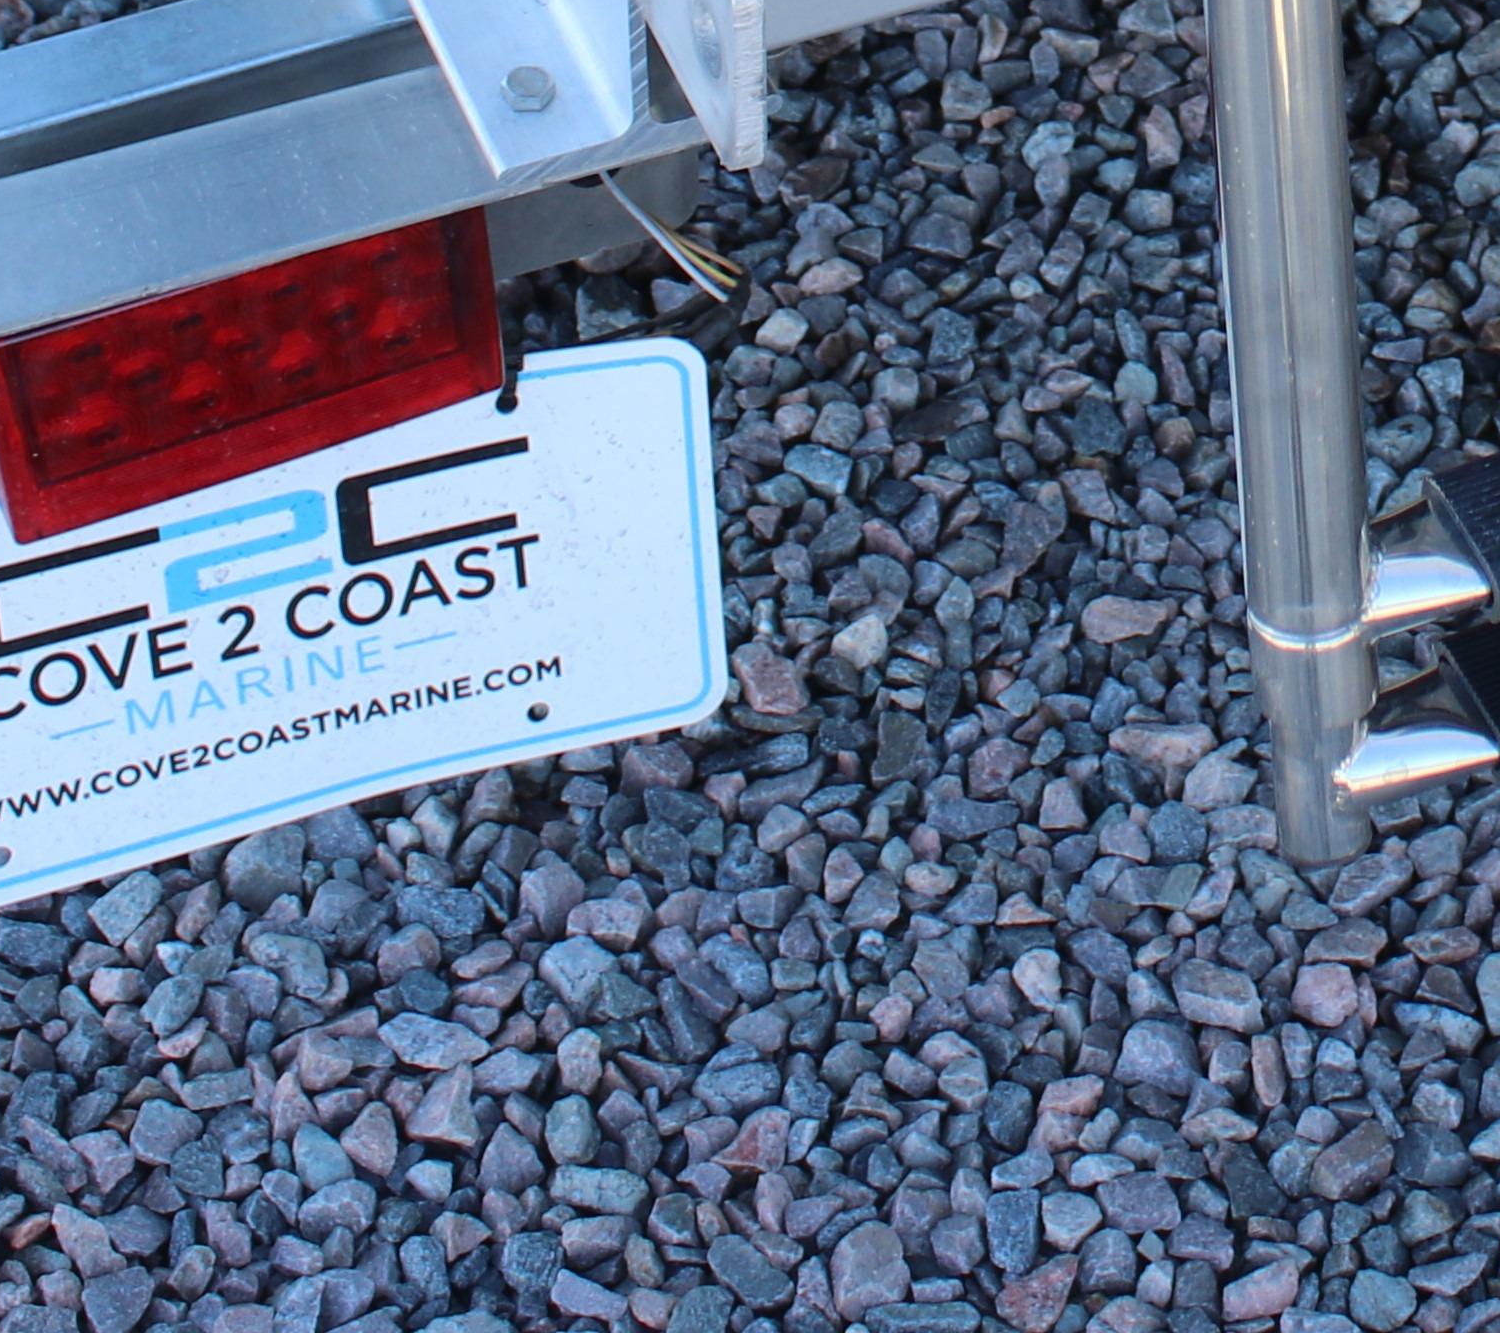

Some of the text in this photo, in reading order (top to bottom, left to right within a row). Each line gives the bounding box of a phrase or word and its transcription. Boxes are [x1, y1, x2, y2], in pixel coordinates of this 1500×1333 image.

[219, 605, 260, 662] 2
[286, 533, 540, 640] COAST
[124, 635, 387, 736] MARINE
